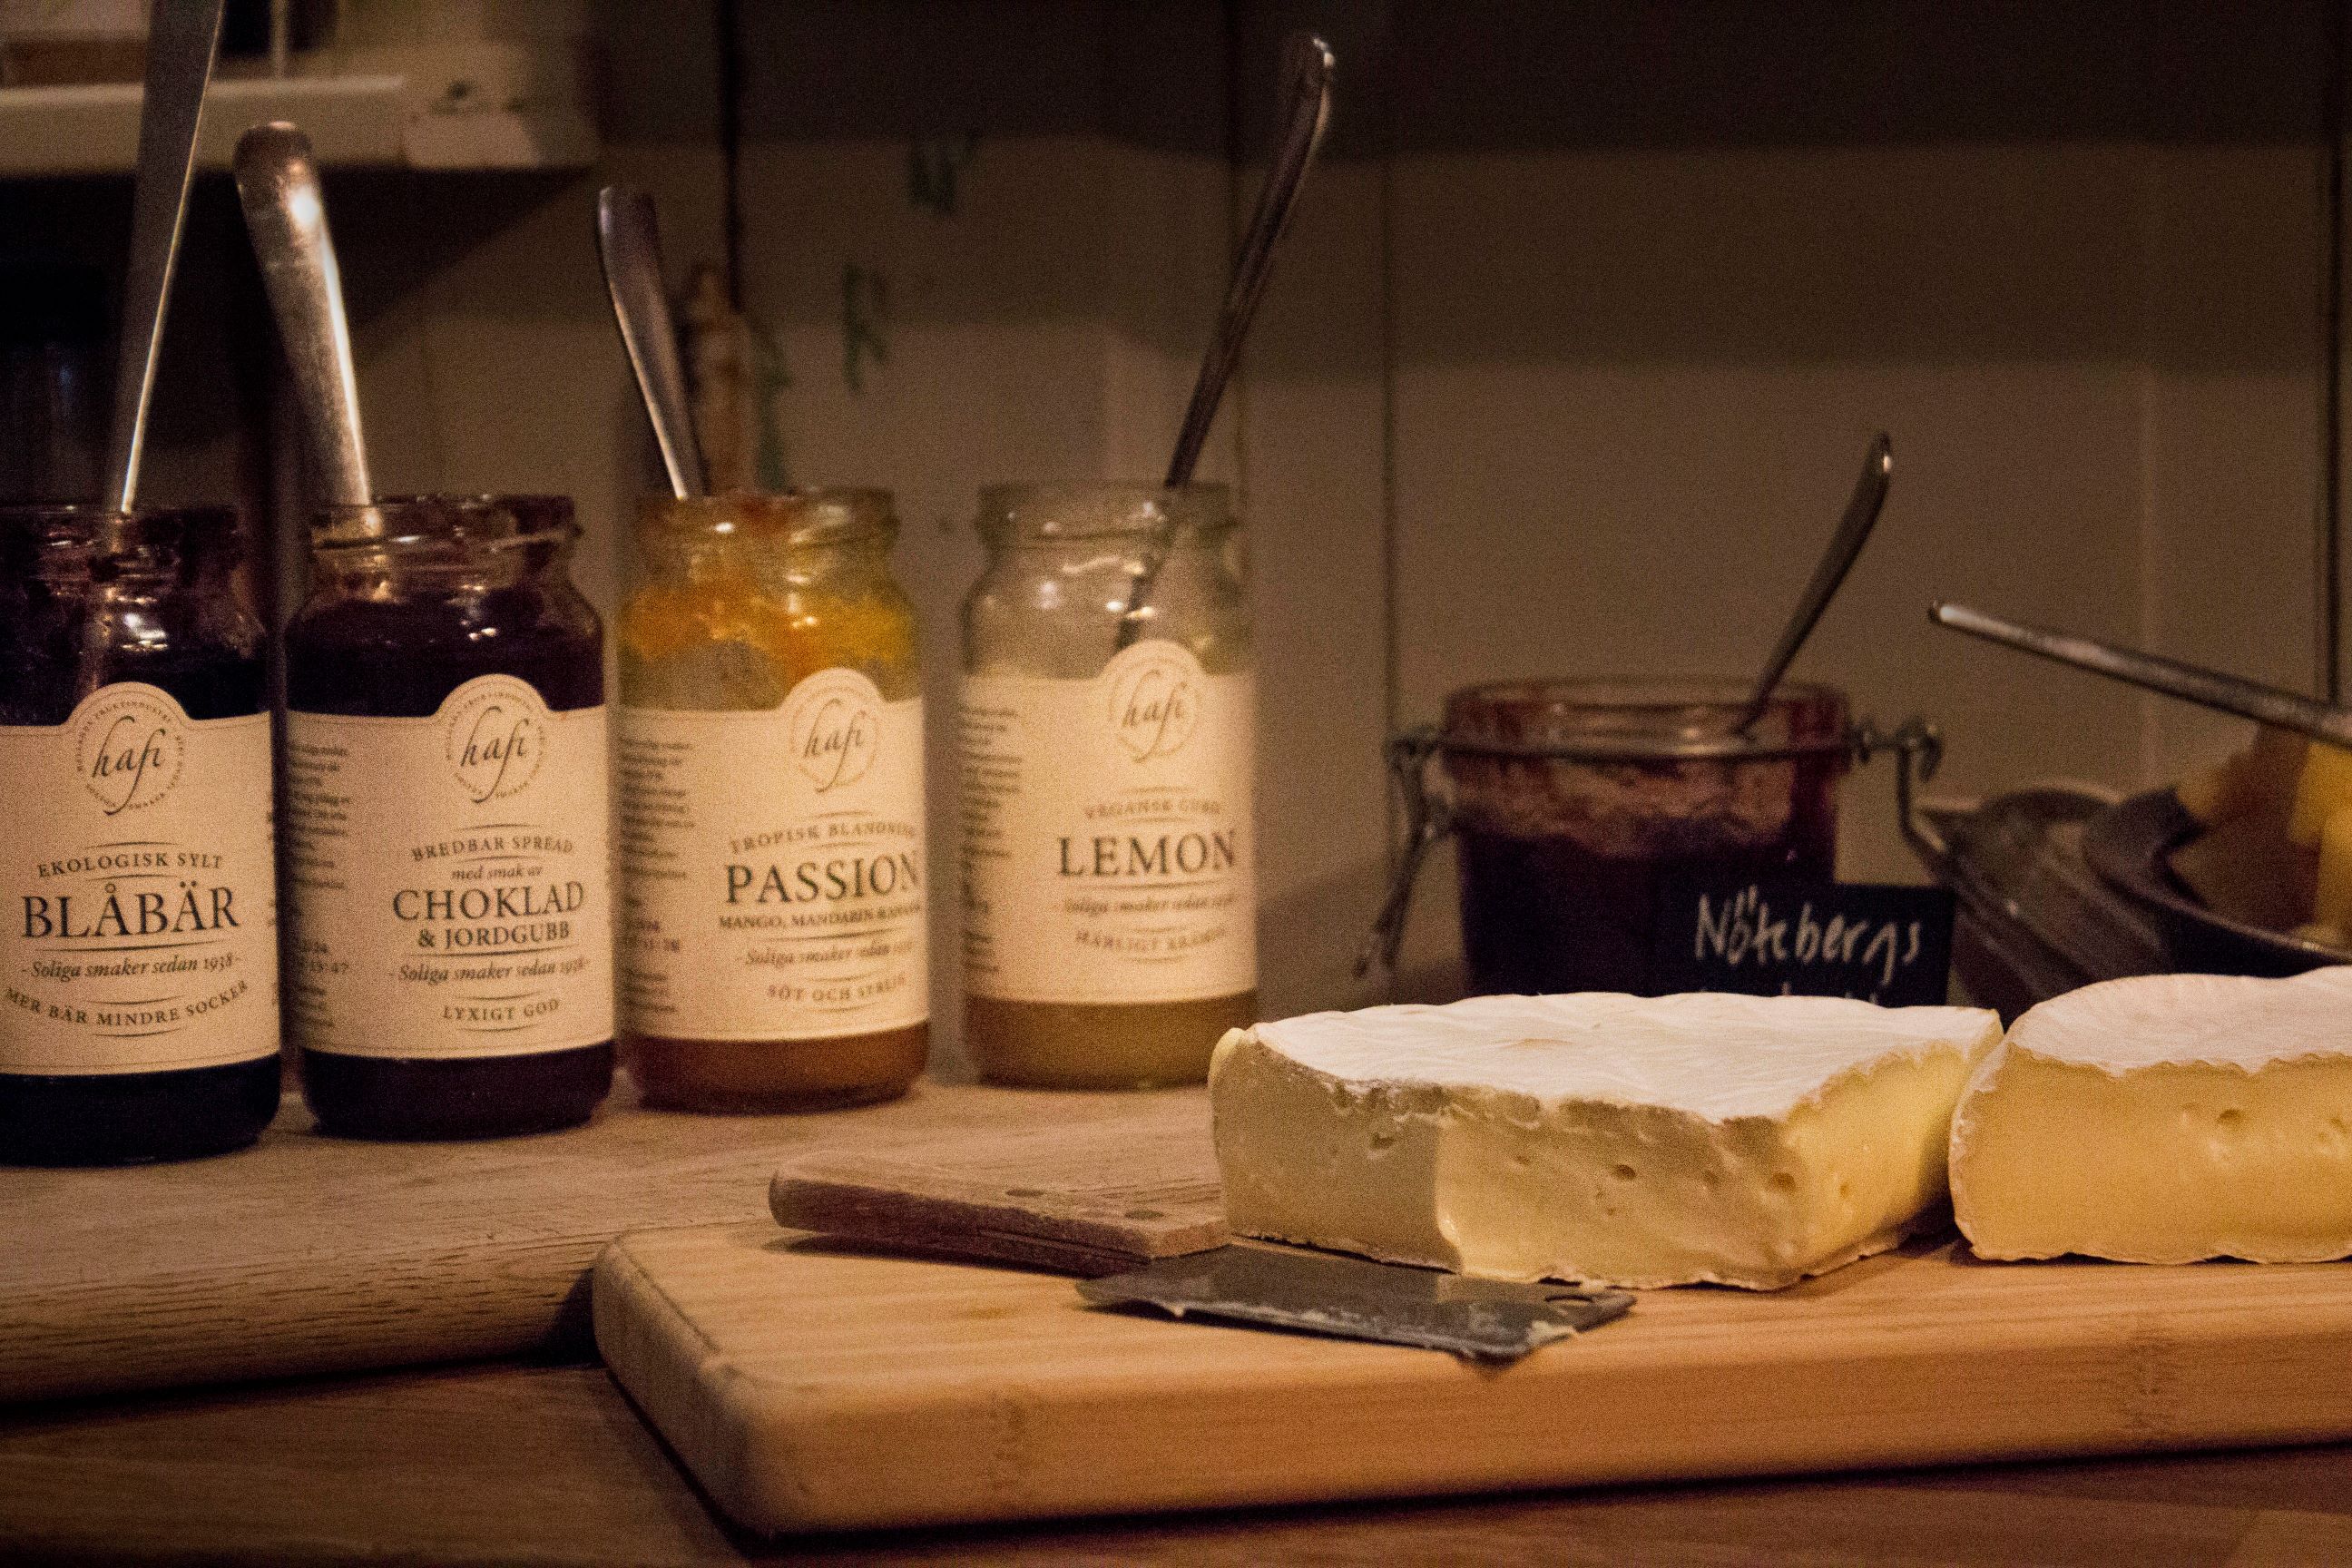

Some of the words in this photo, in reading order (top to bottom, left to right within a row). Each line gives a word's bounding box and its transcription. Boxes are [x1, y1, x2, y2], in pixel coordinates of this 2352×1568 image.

[91, 715, 166, 816] hafi
[460, 705, 530, 804] hafi
[411, 837, 505, 862] BREDBAR
[511, 835, 574, 854] SPREAD
[730, 825, 820, 855] TROPISK
[1057, 828, 1237, 877] LEMON
[38, 852, 169, 878] EKOLOGISK
[176, 852, 223, 869] SYLT
[452, 865, 484, 880] med
[487, 866, 524, 880] smak
[726, 850, 918, 905] PASSION
[22, 879, 240, 939] BLÅBÄR
[392, 880, 584, 920] CHOKLAD
[417, 928, 436, 948] &
[444, 920, 570, 950] JORDGUBB
[84, 956, 149, 977] smaker
[152, 955, 199, 974] sedan
[455, 960, 514, 980] smaker
[515, 957, 556, 976] sedan
[6, 985, 42, 1014] MER
[48, 1004, 88, 1024] BÄR
[96, 1006, 181, 1027] MINDRE
[186, 978, 249, 1017] SOCKER
[812, 987, 851, 1002] OCH
[442, 1004, 515, 1022] LYXIGT
[524, 998, 560, 1018] GOD
